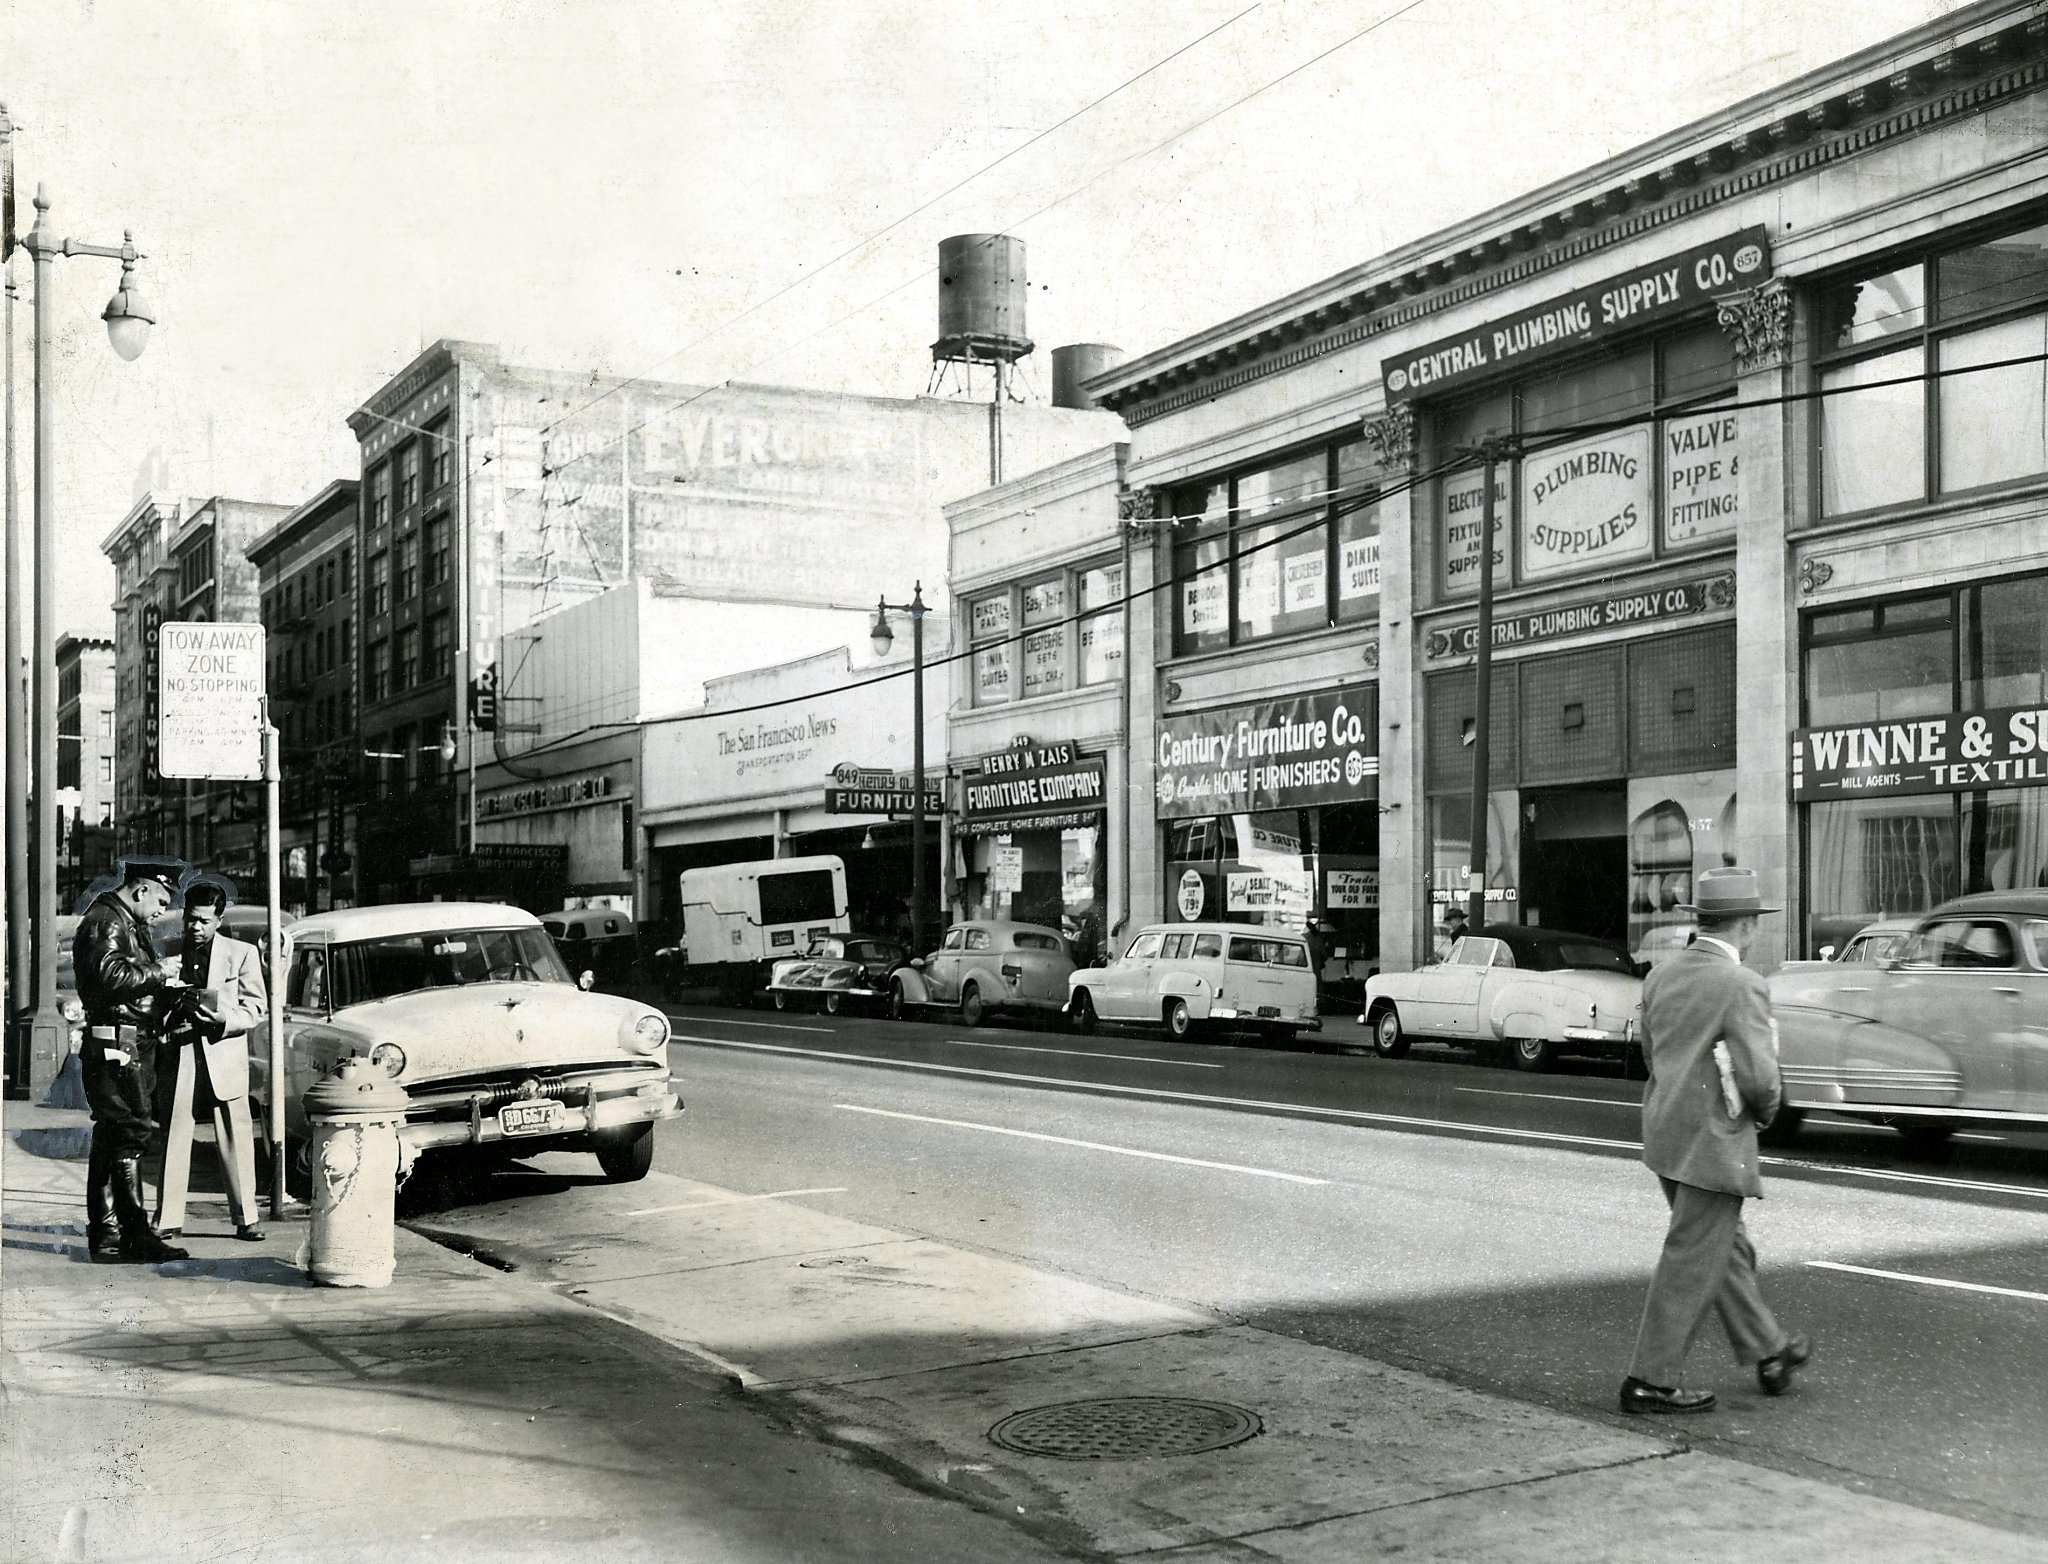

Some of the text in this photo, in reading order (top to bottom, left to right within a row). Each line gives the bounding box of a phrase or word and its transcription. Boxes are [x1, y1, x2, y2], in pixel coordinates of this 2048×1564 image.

[1408, 339, 1487, 388] CENTRAL
[1493, 302, 1592, 360] PLUMBING
[1599, 267, 1680, 325] SUPPLY
[1695, 253, 1734, 291] CO.
[1736, 250, 1760, 267] 857
[1533, 451, 1638, 504] PLUMBING
[1672, 461, 1722, 490] PIPE
[1448, 482, 1507, 515] ELECTAL
[1448, 515, 1503, 543] FIXTUES
[1533, 502, 1639, 554] SUPPLIES
[1448, 549, 1504, 575] SUPPES
[1464, 589, 1689, 648] CETRAL PLUMBING SUPPLY CO.
[167, 631, 257, 650] TOW AWAY
[187, 655, 237, 674] ZONE
[146, 613, 159, 780] HOTEL IRWIN
[167, 679, 257, 692] NO STOPPING
[718, 713, 837, 756] The San Francisco News
[1159, 705, 1366, 769] Century Furniture Co.
[1809, 720, 1949, 772] WINNE
[1962, 716, 1994, 759] &
[983, 753, 1020, 774] HENRY
[1038, 746, 1069, 767] ZAIS
[836, 768, 859, 784] 849
[859, 776, 895, 790] HENRY
[1213, 769, 1248, 794] HOME
[1254, 757, 1341, 791] FURNISHERS
[1841, 778, 1864, 789] MILL
[1866, 774, 1902, 788] AGENTS
[967, 771, 1101, 810] FURNITURE COMPANY
[971, 820, 1009, 833] COMPLETE
[1012, 818, 1033, 829] HOME
[1034, 813, 1078, 827] FURNITURE
[475, 859, 533, 869] URNITURE
[1338, 873, 1375, 884] Trade
[1348, 885, 1360, 894] OLD
[1342, 895, 1380, 904] FOR NE
